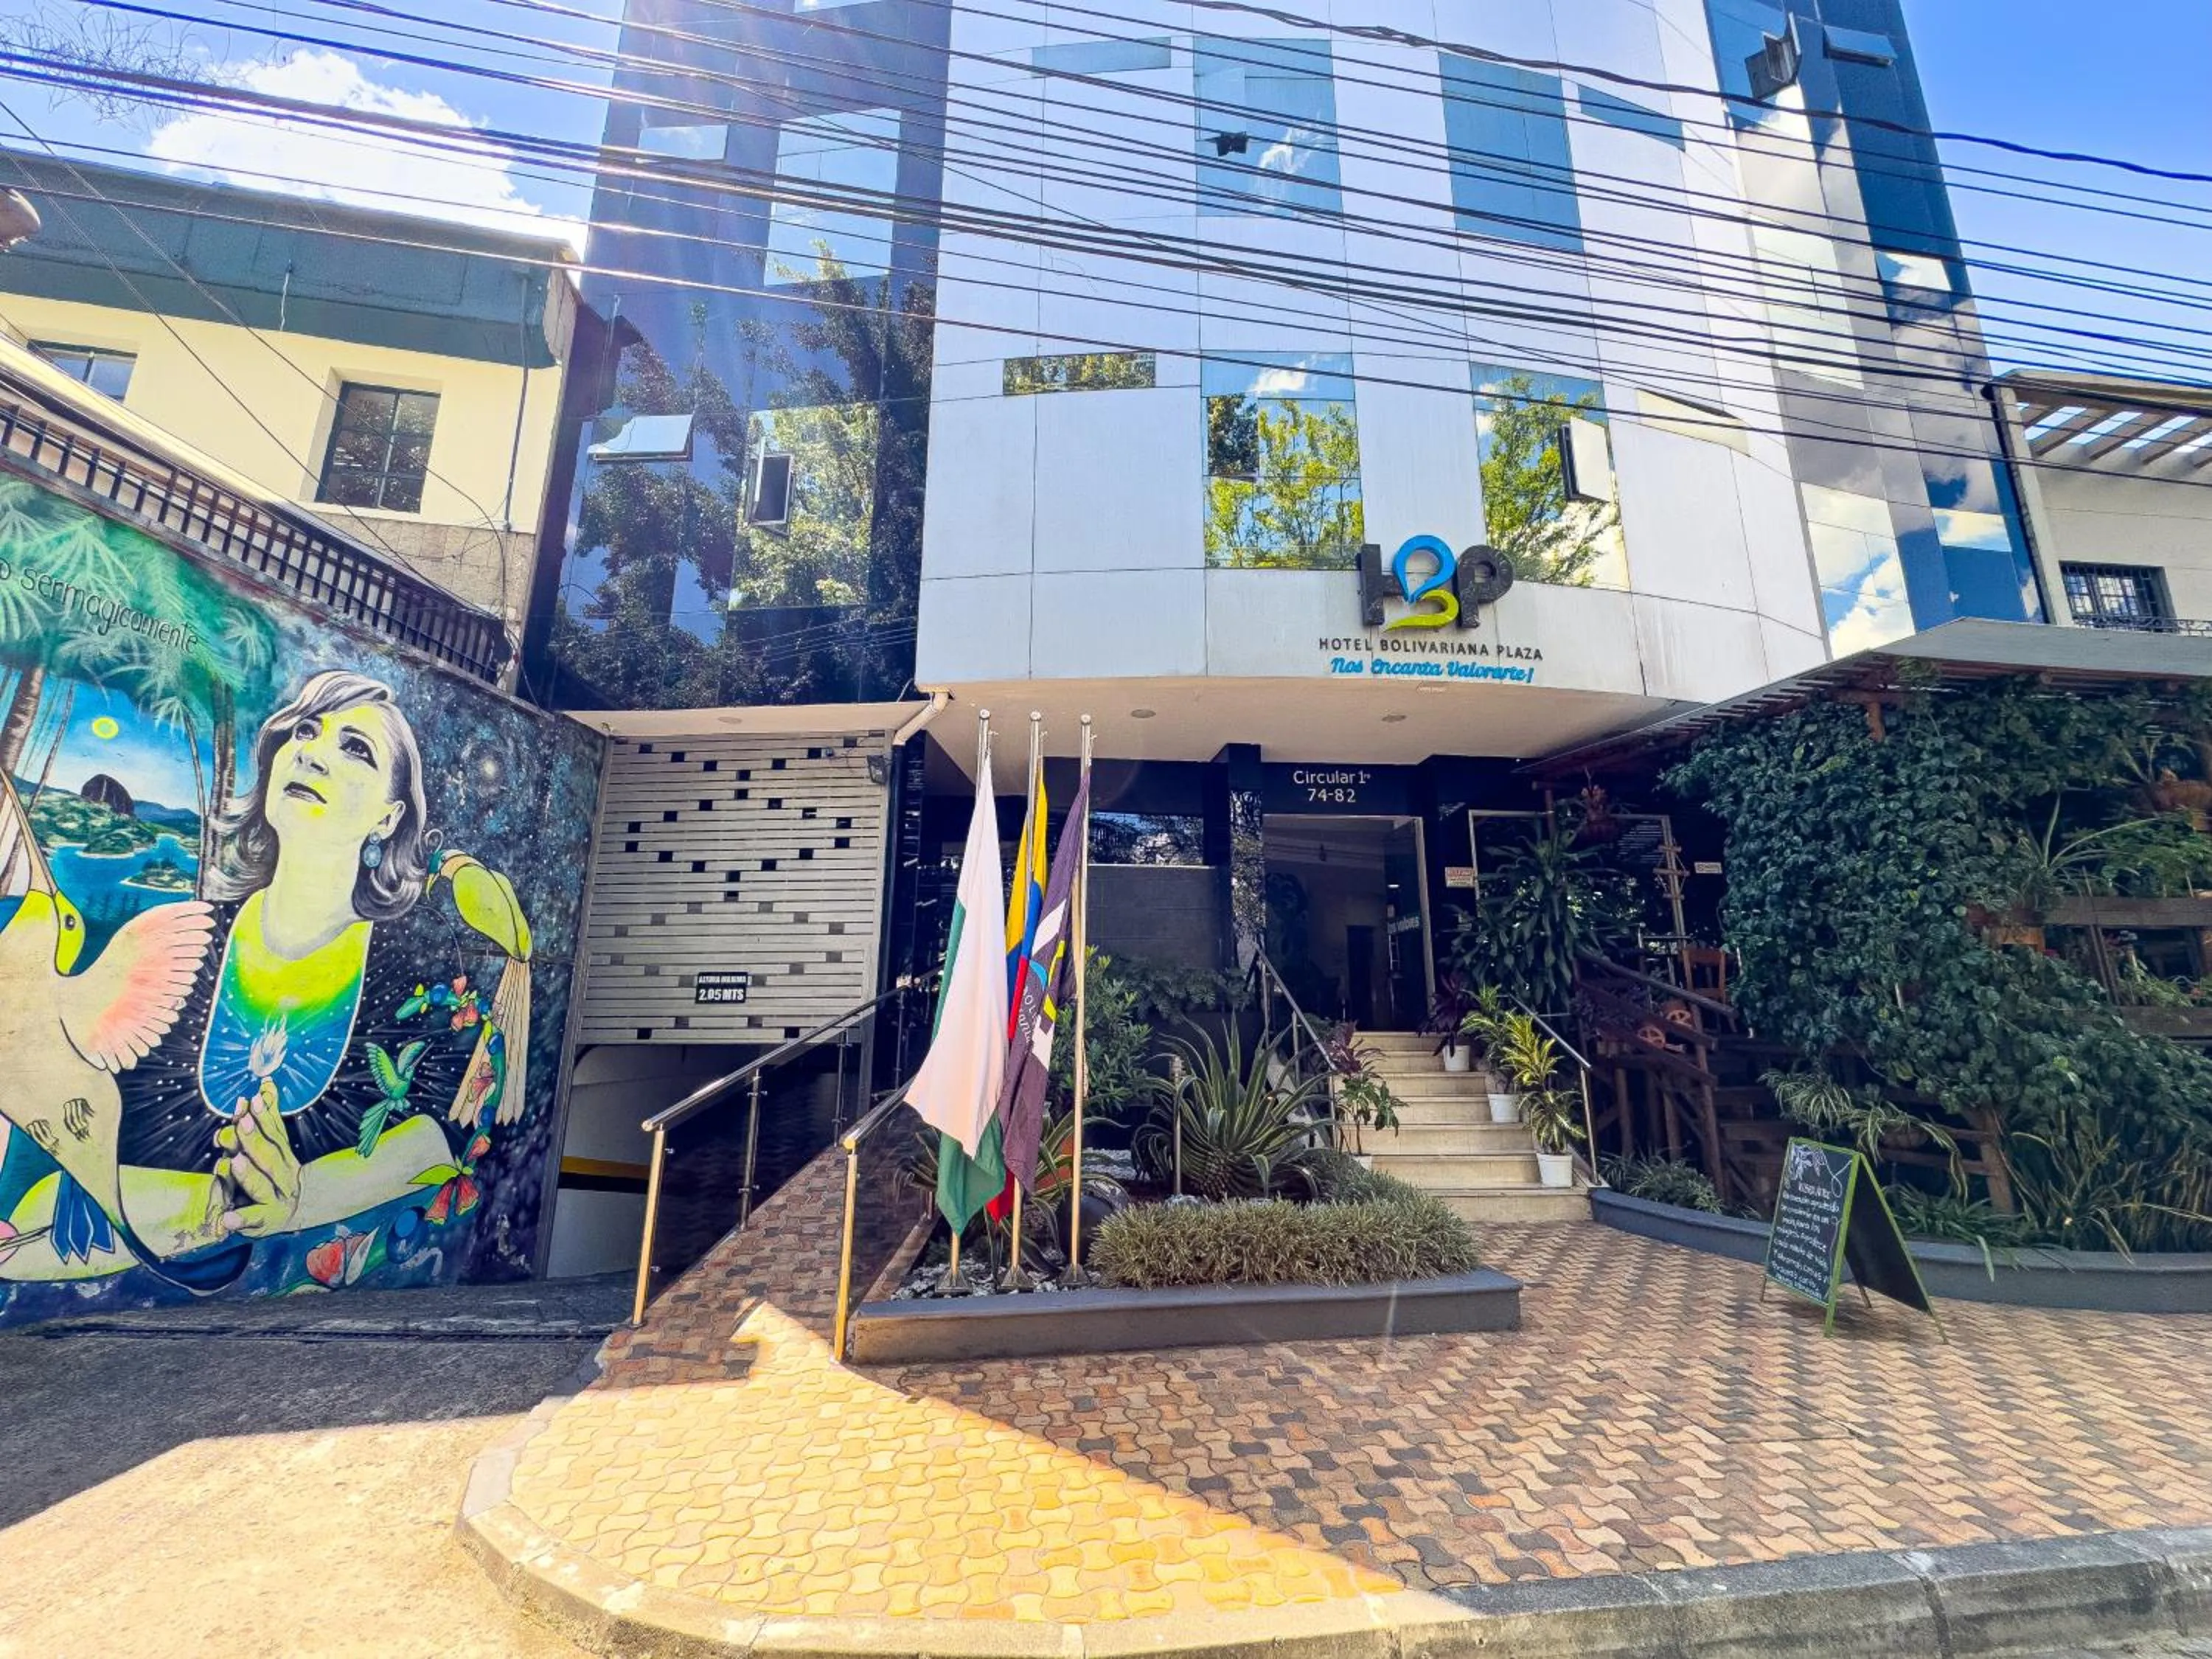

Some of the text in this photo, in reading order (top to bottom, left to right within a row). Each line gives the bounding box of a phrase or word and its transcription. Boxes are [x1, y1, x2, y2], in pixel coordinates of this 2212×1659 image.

[1318, 638, 1543, 661] HOTEL BOLIVARIANA PLAZA
[1330, 657, 1534, 684] Nos Encanta Valorarte!
[1293, 770, 1356, 785] Circular
[1307, 787, 1357, 803] 74-82
[722, 989, 744, 1001] MTS
